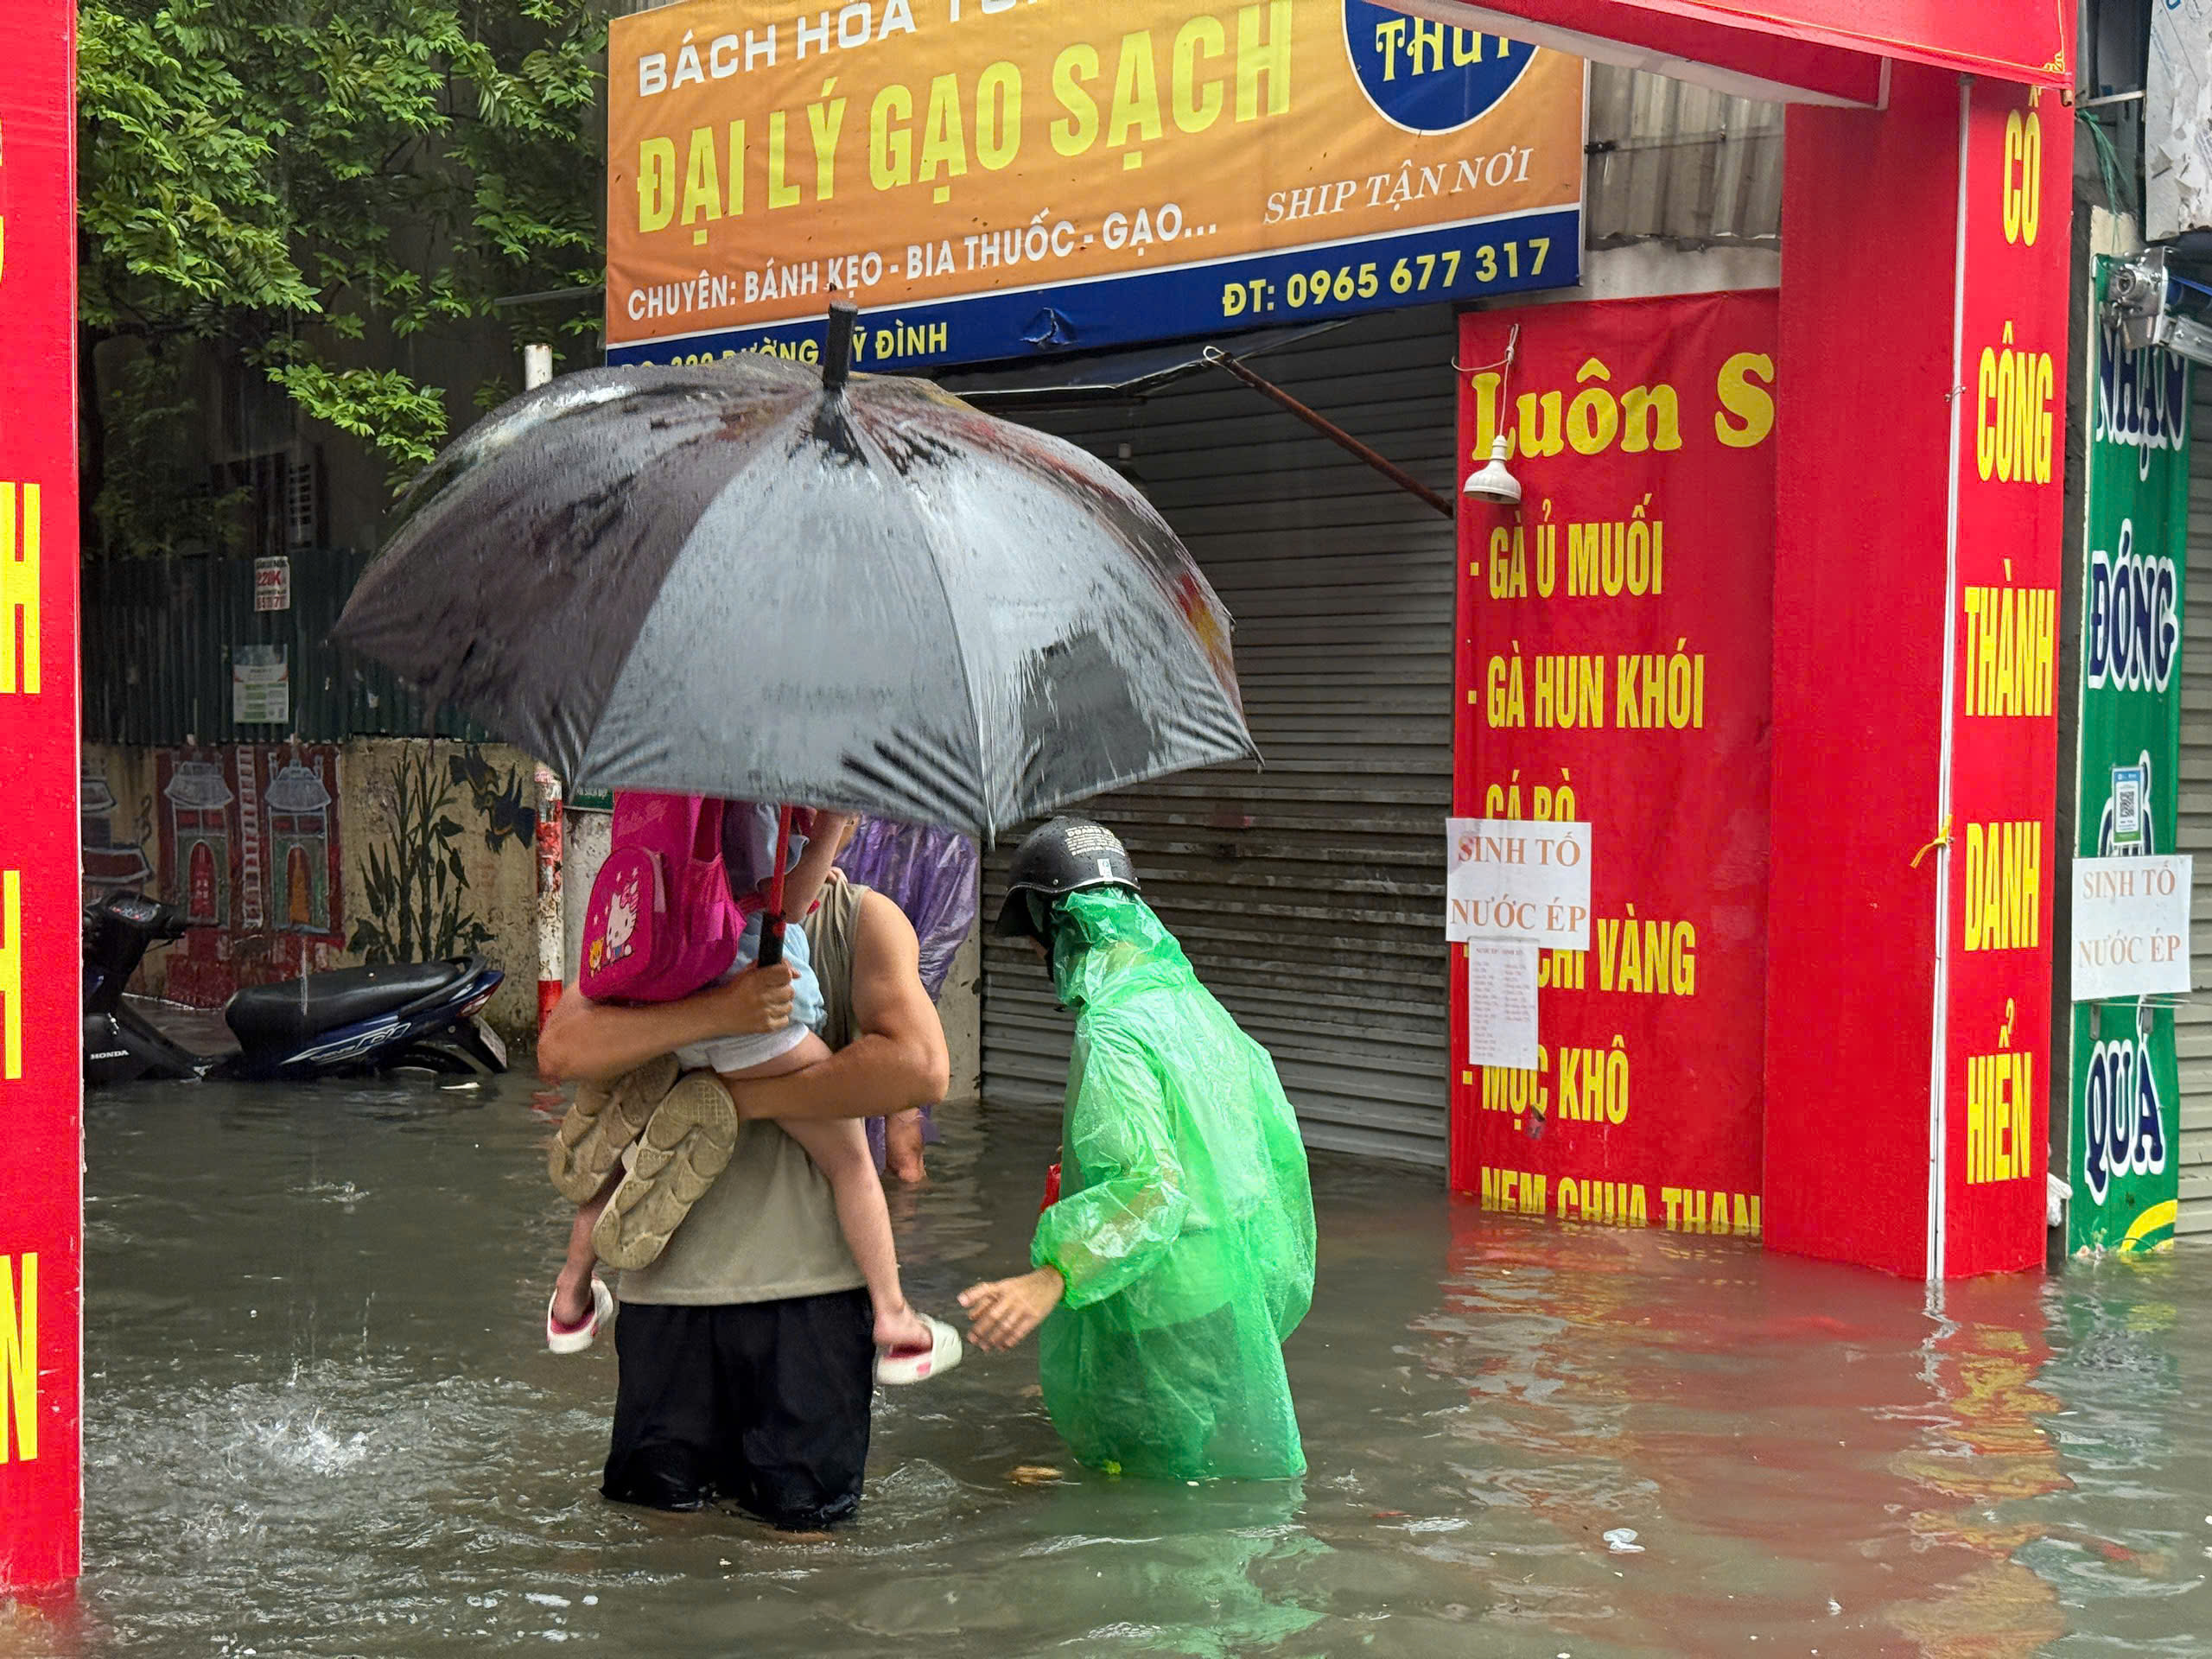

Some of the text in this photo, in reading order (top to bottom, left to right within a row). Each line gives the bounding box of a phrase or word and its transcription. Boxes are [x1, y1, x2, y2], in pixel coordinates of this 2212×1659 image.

[639, 29, 777, 98] BÁCH
[637, 0, 1293, 245] ĐẠI LÝ GẠO SẠCH
[1263, 148, 1534, 225] SHIP TẬN NƠI
[628, 270, 735, 321] CHUYÊN:
[745, 257, 818, 304] BÁNH
[829, 251, 882, 297] KẸO
[906, 239, 956, 280] BIA
[965, 208, 1074, 270] THUỐC
[1103, 203, 1217, 257] GẠO...
[1223, 238, 1550, 317] ĐT: 0965 677 317
[875, 318, 947, 359] ĐÌNH
[1471, 357, 1682, 461] Luôn
[1977, 321, 2053, 485] CÔNG
[1490, 493, 1663, 600] GÀ Ủ MUỐI
[1964, 558, 2056, 716] THÀNH
[2088, 518, 2178, 693] ĐÓNG
[1486, 638, 1706, 729] GÀ HUN KHÓI
[1458, 832, 1581, 867] SINH TỐ
[1965, 822, 2041, 951] DANH
[2082, 863, 2176, 899] SINH TỐ
[1451, 894, 1586, 934] NƯỚC ÉP
[1598, 903, 1696, 995] VÀNG
[2079, 928, 2181, 967] NƯỚC ÉP
[90, 1050, 130, 1060] HONDA
[1559, 1034, 1630, 1124] KHÔ
[1967, 998, 2032, 1185] HIỂN
